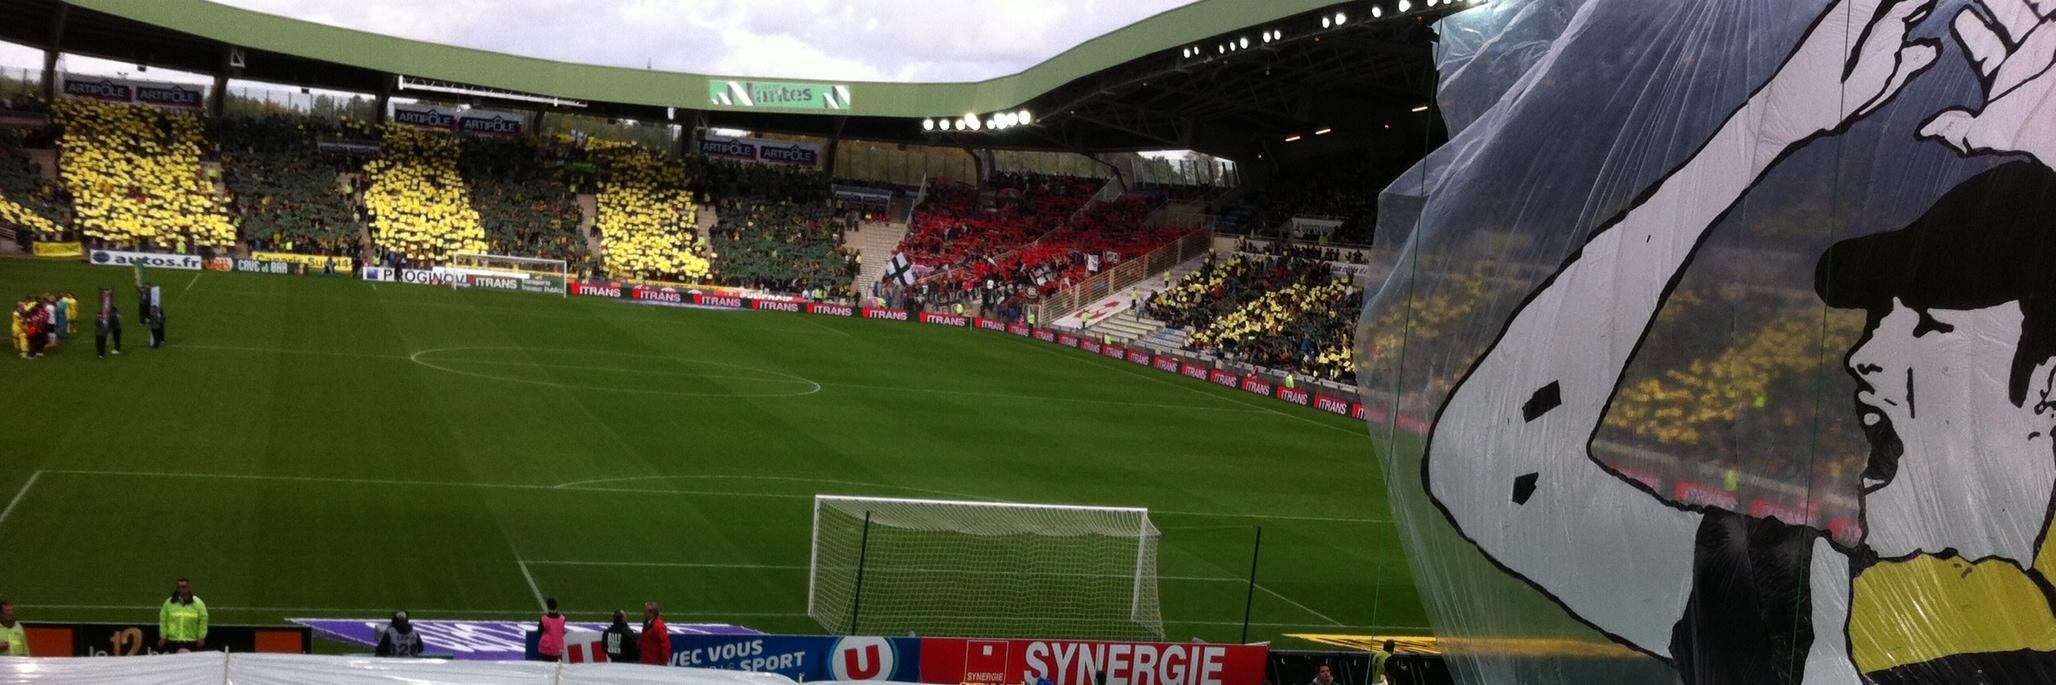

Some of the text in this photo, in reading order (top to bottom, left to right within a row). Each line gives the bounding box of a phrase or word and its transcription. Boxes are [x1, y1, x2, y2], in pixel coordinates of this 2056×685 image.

[475, 278, 517, 289] ITRANS
[580, 286, 621, 298] ITRANS
[640, 290, 680, 302] ITRANS
[702, 295, 741, 307] ITRANS
[760, 300, 798, 312] ITRANS
[814, 305, 852, 317] ITRANS
[869, 310, 908, 321] ITRANS
[927, 314, 965, 327] ITRANS
[982, 320, 1005, 331] ITRANS
[1156, 360, 1177, 373] ITRANS
[1185, 365, 1207, 380] ITRANS
[1214, 372, 1237, 387] ITRANS
[1245, 380, 1270, 396] ITRANS
[1281, 388, 1308, 405] ITRANS
[1318, 397, 1347, 415] ITRANS
[667, 640, 764, 667] VEC VOUS
[740, 651, 806, 672] SPORT
[1024, 641, 1226, 685] SYNERGIE
[967, 672, 1004, 682] SYNERGIE
